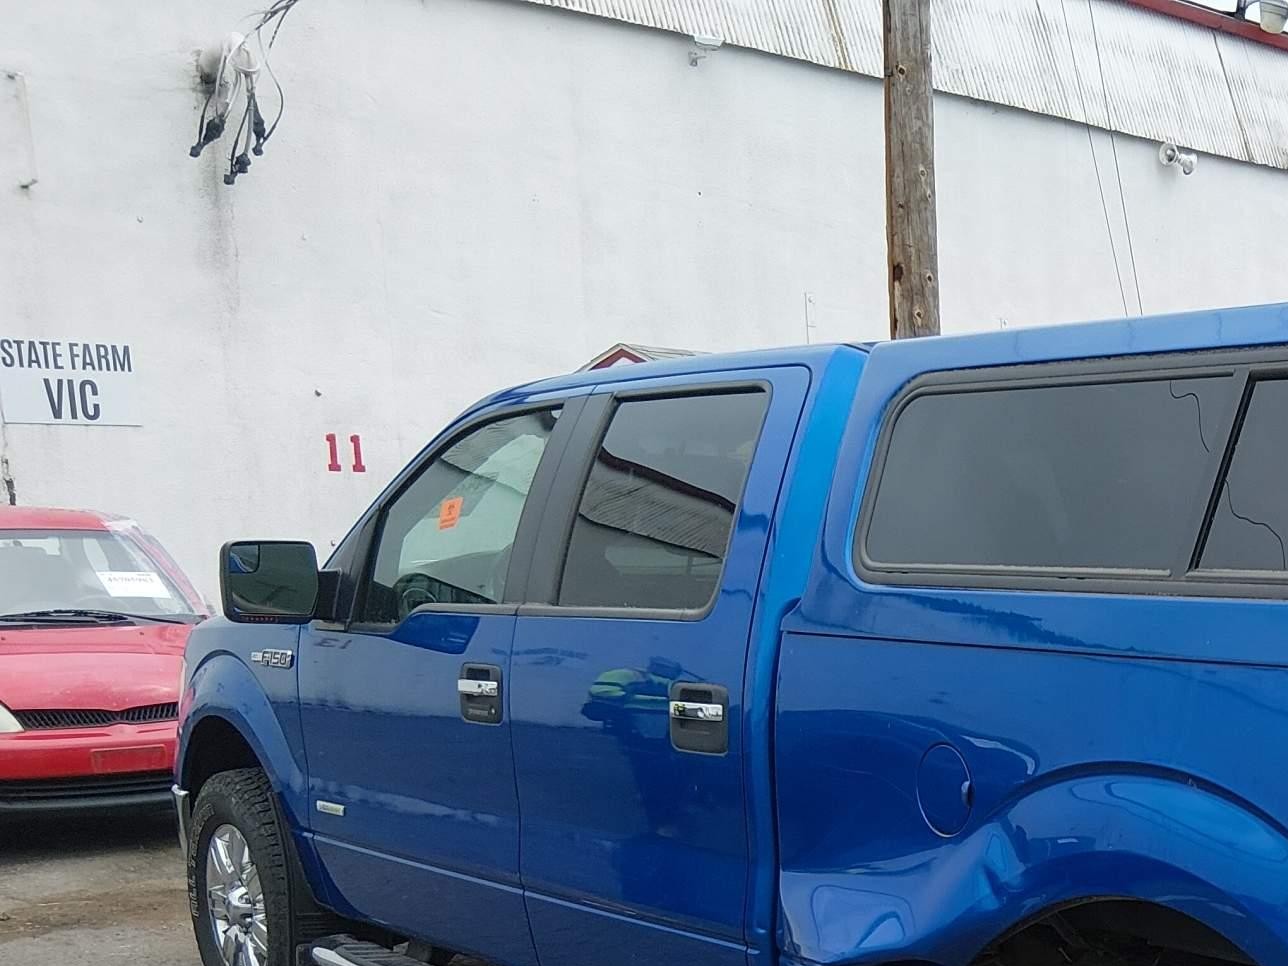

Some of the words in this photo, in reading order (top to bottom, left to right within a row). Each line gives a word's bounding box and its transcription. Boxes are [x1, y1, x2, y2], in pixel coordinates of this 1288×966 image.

[0, 338, 65, 370] STATE
[69, 342, 133, 373] FARM
[43, 377, 101, 421] VIC
[325, 433, 366, 472] 11
